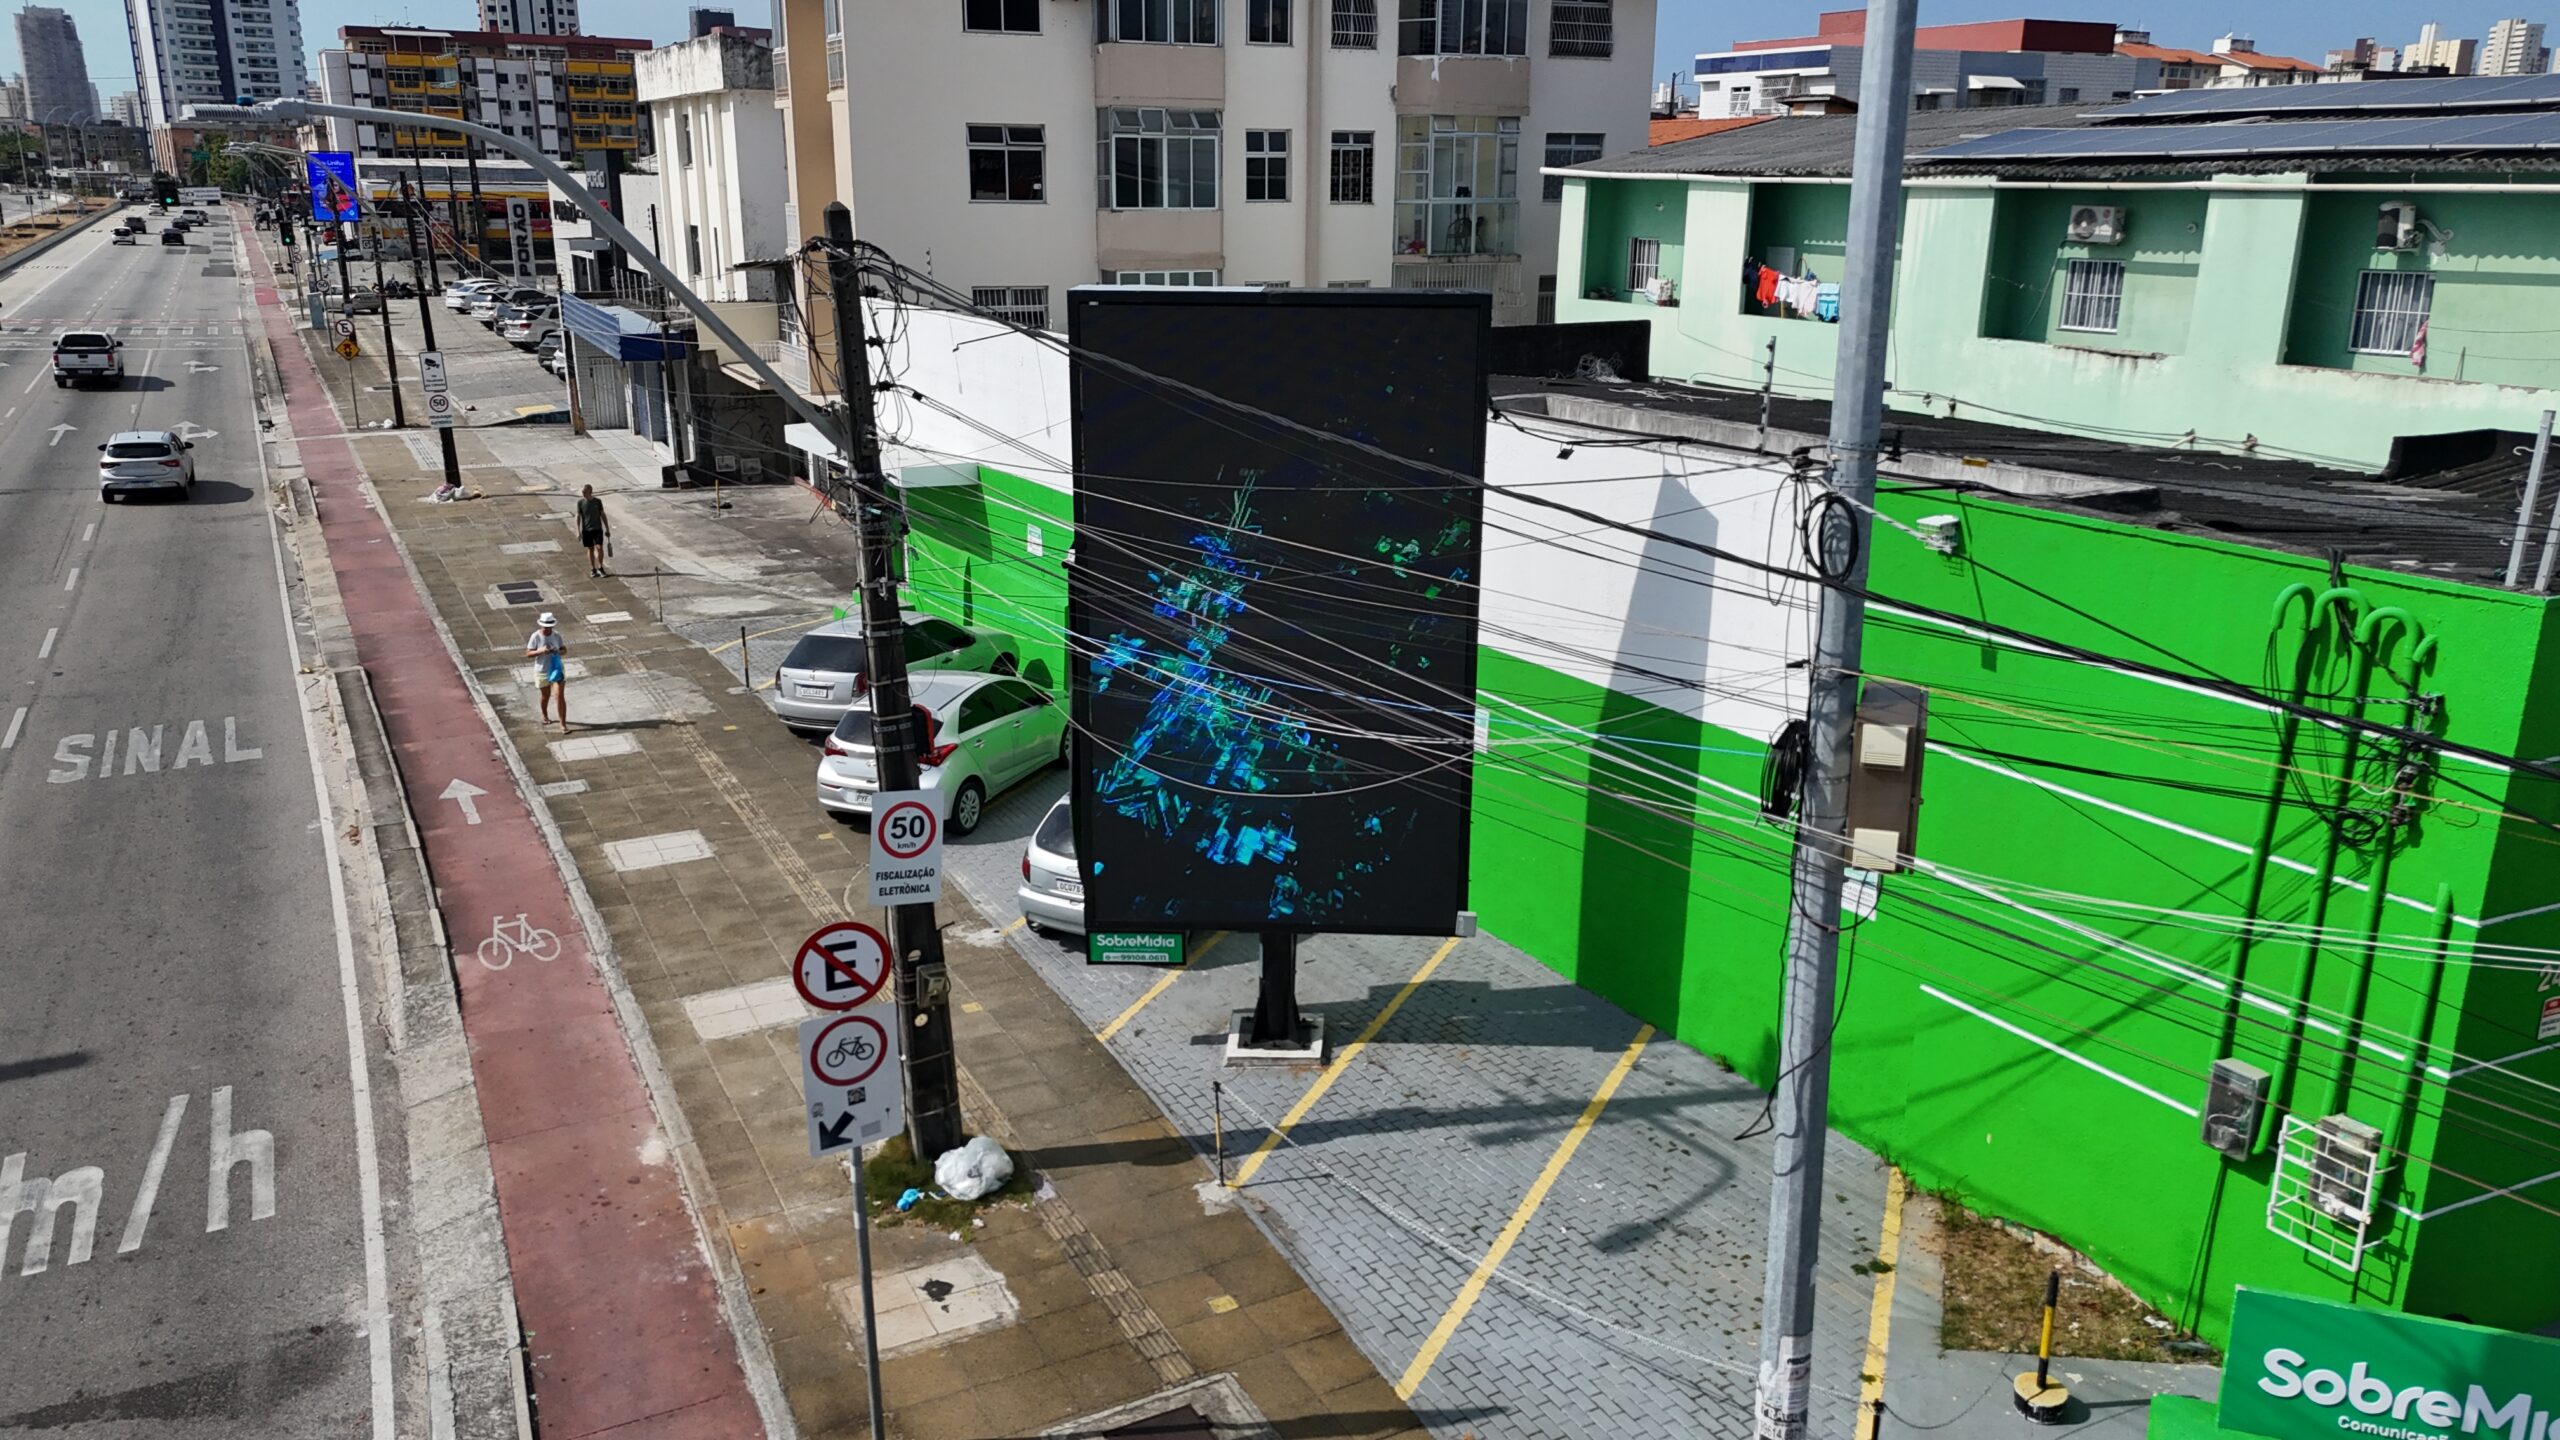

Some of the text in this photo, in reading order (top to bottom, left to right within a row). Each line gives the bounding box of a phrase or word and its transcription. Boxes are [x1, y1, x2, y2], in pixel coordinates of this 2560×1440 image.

[512, 202, 533, 278] PORÃO
[433, 398, 446, 408] 50
[46, 715, 264, 784] SINAL
[890, 814, 926, 840] 50
[897, 842, 917, 850] km/h
[875, 865, 936, 882] FISCALIZAÇÃO
[878, 884, 931, 897] ELETRÔNICA
[823, 939, 861, 993] E
[2257, 1347, 2560, 1440] SobreMi
